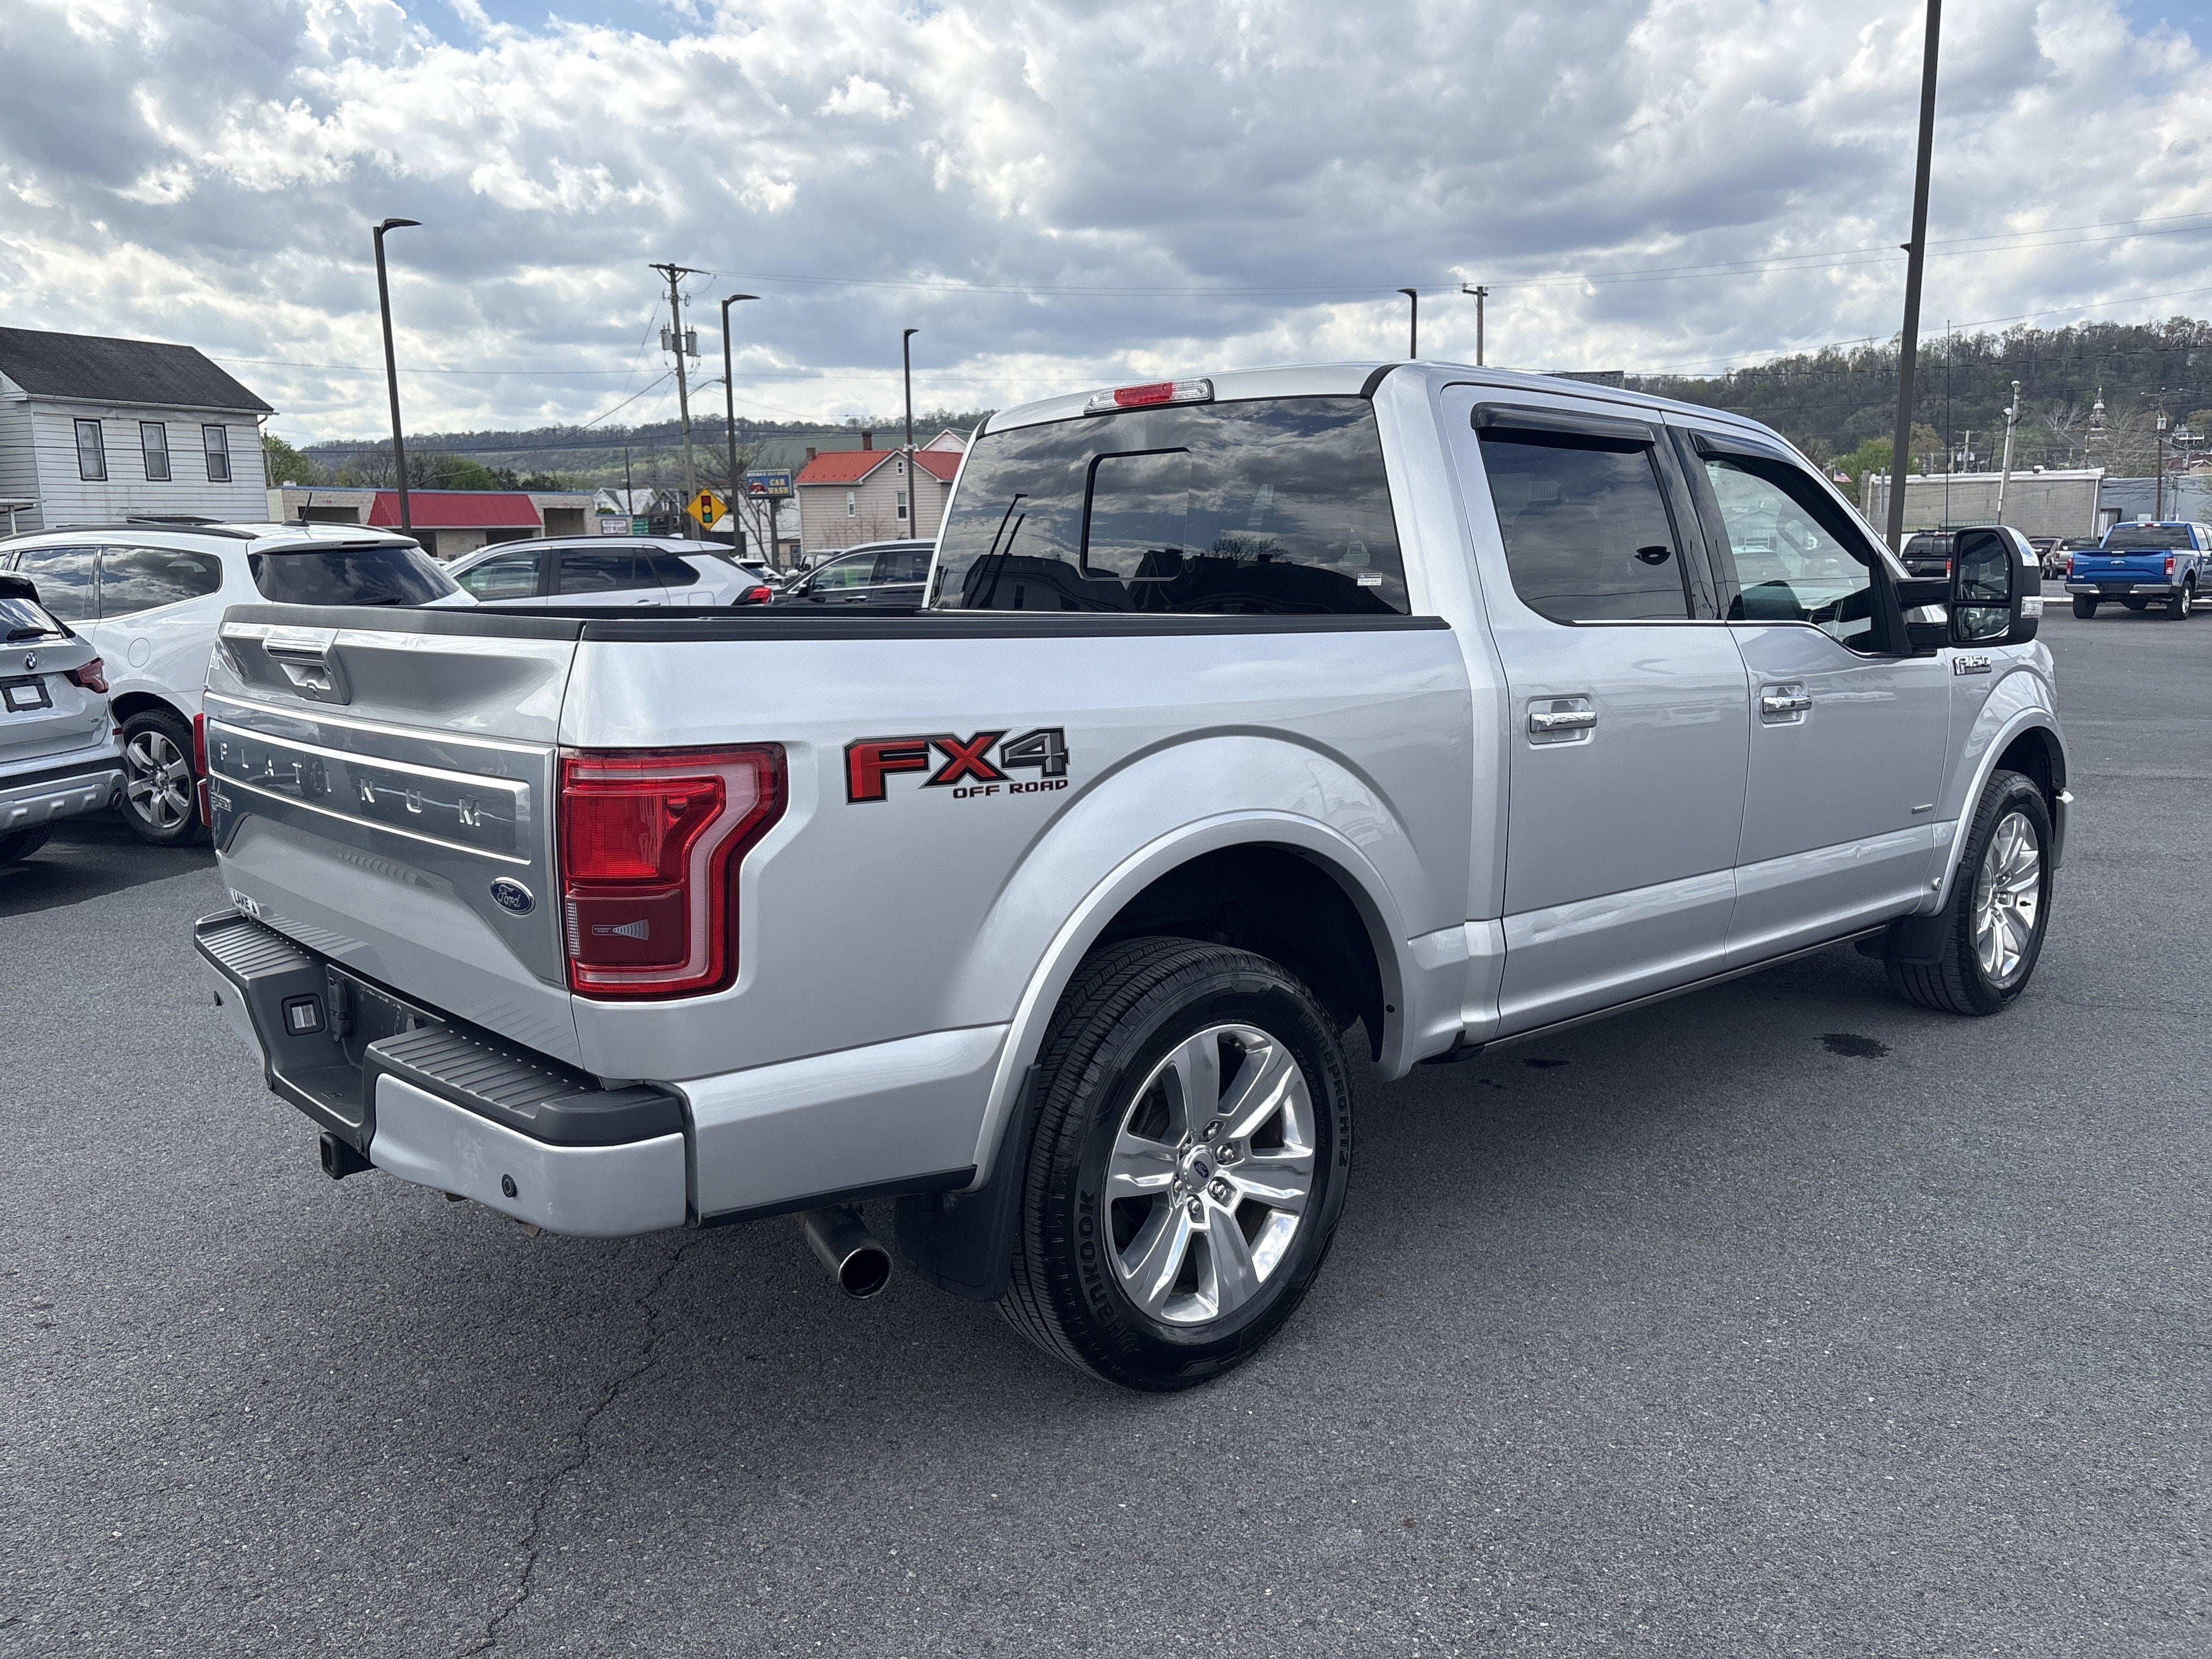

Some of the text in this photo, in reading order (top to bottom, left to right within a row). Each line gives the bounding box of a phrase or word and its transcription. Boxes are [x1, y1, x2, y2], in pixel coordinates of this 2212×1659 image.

[842, 725, 1070, 805] FX4
[220, 740, 481, 826] PLATINUM
[953, 779, 1069, 799] OFF ROAD
[233, 891, 251, 911] LAKE
[496, 884, 521, 908] Ford
